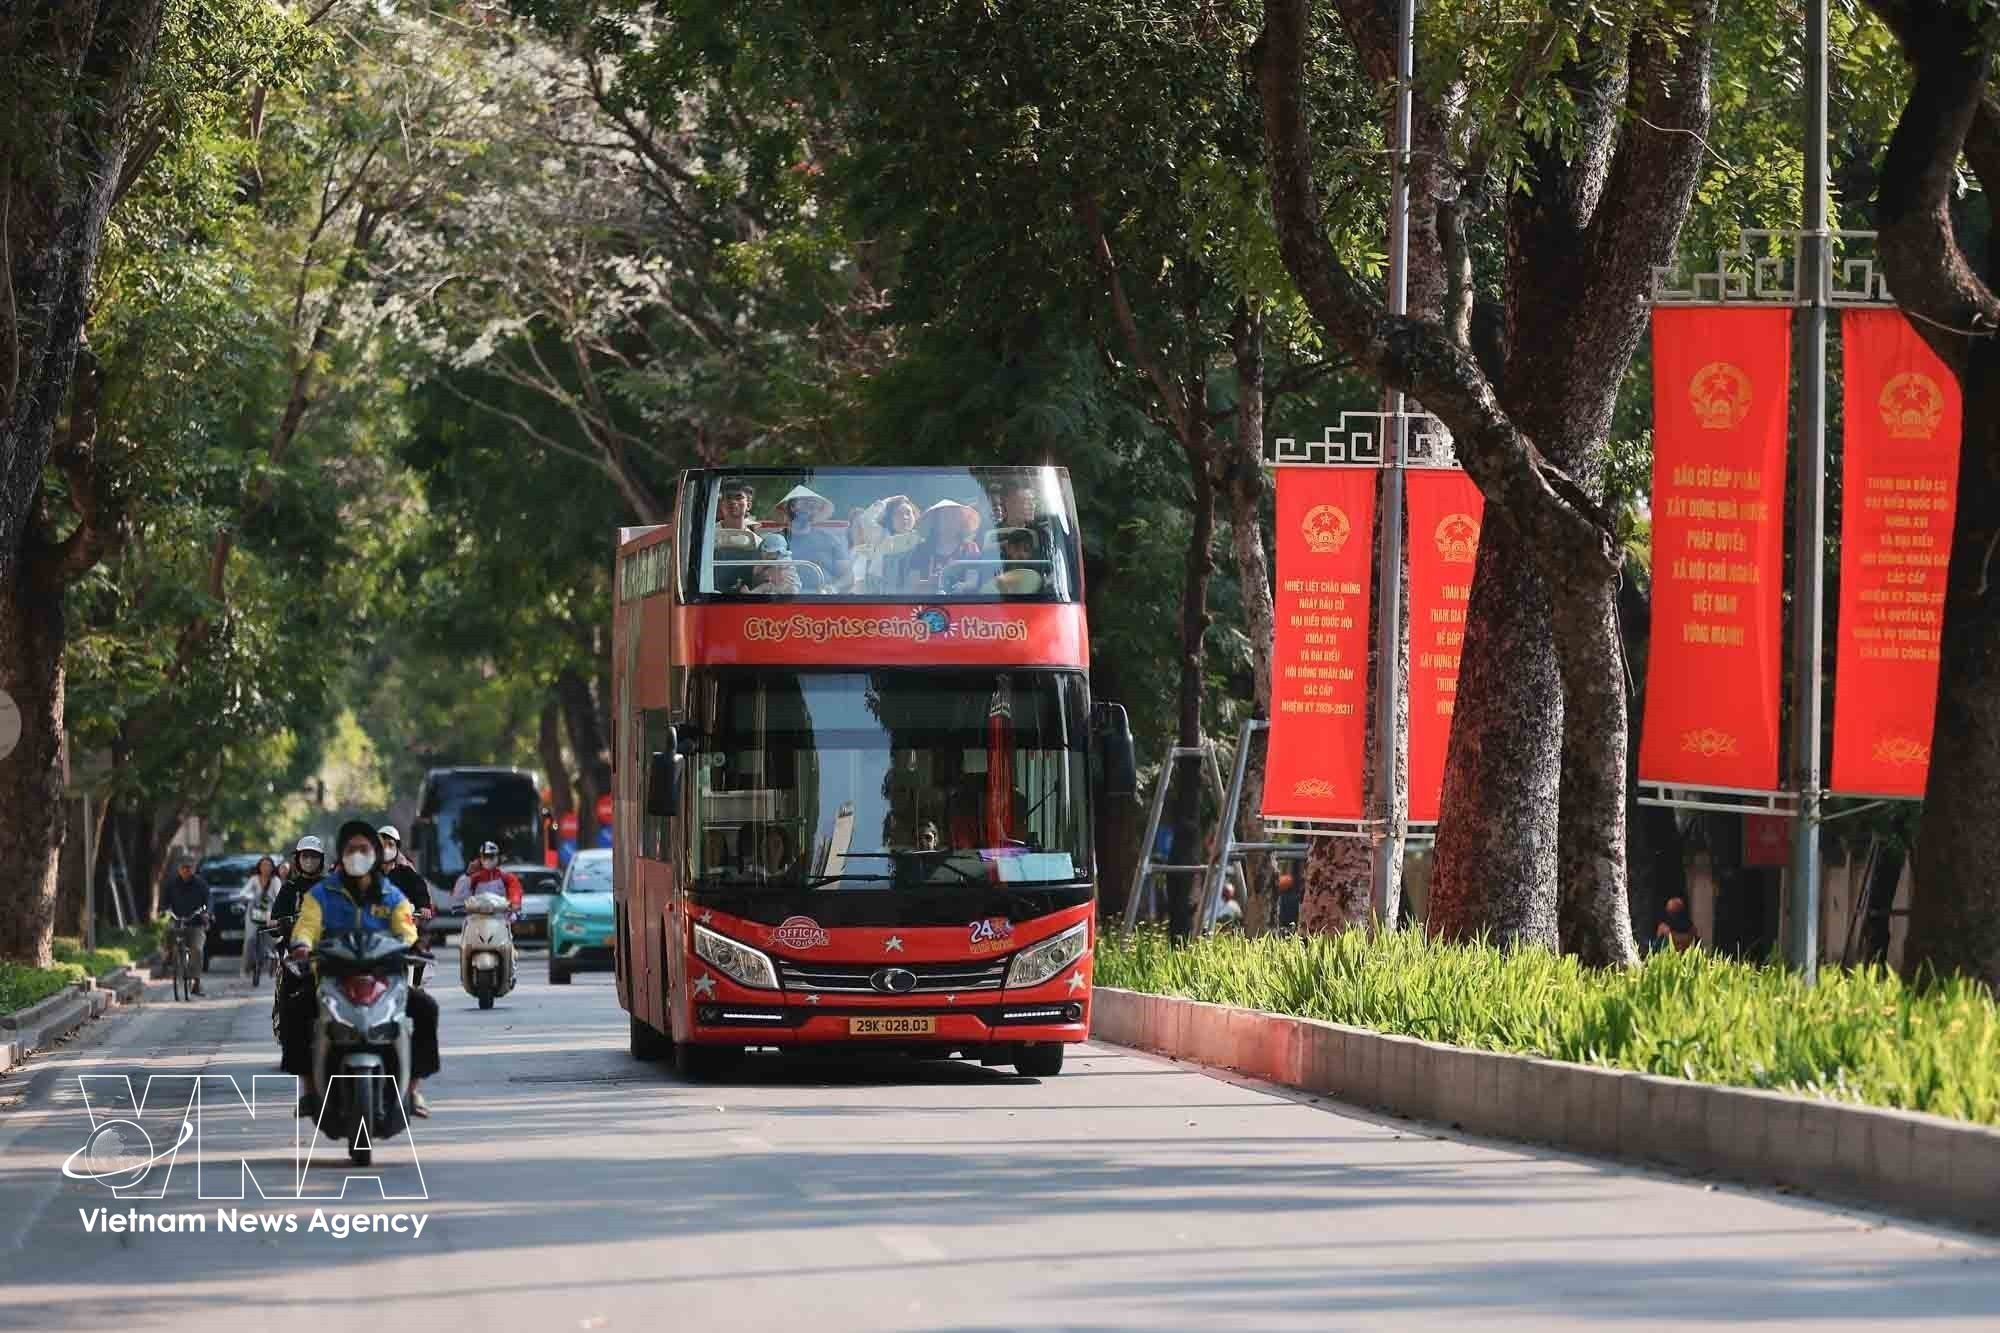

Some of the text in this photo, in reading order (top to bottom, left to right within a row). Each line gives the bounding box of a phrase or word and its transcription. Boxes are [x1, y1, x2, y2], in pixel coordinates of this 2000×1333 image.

[744, 616, 1027, 641] City Sightseeing Hanoi
[778, 928, 824, 938] OFFICIAL
